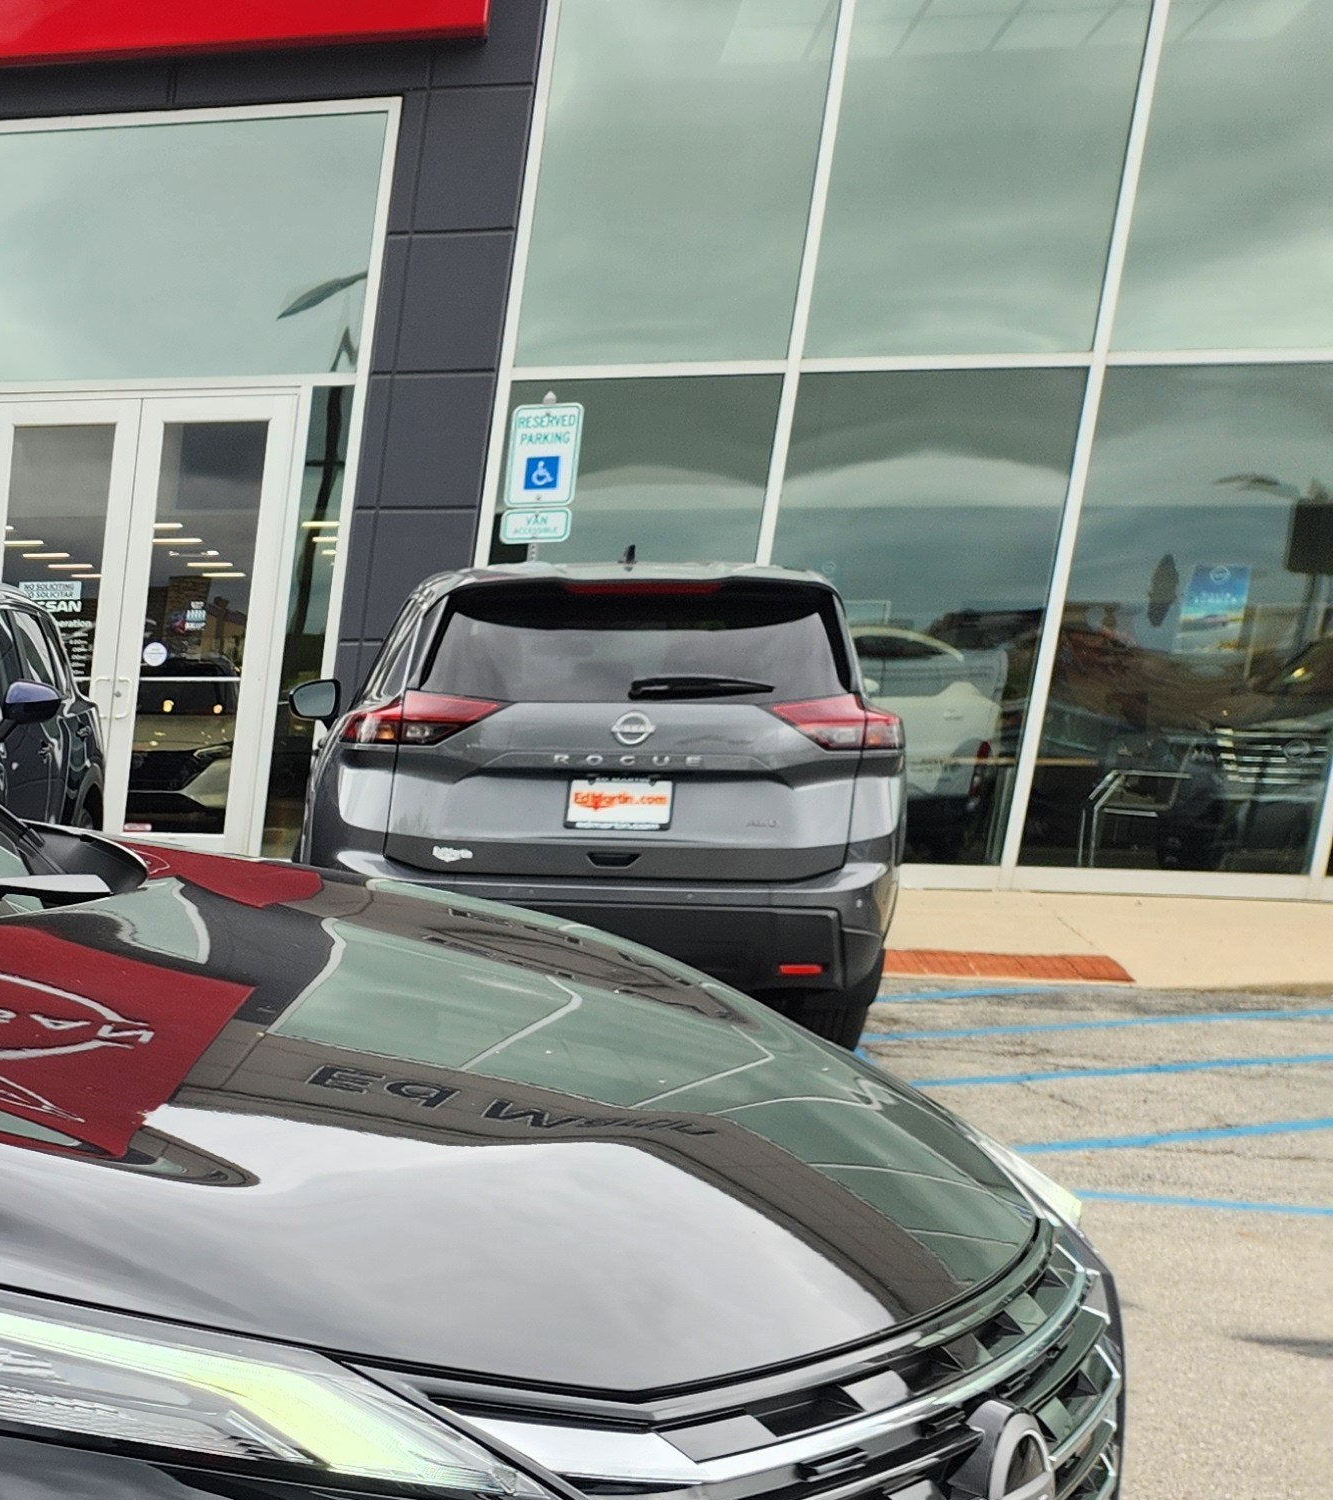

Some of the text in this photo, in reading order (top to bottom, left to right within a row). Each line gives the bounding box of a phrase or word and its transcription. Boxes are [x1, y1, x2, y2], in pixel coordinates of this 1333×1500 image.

[517, 414, 576, 429] RESERVED
[520, 431, 571, 445] PARKING
[527, 515, 548, 525] VAN
[24, 583, 35, 592] NO
[552, 753, 703, 767] ROGUE
